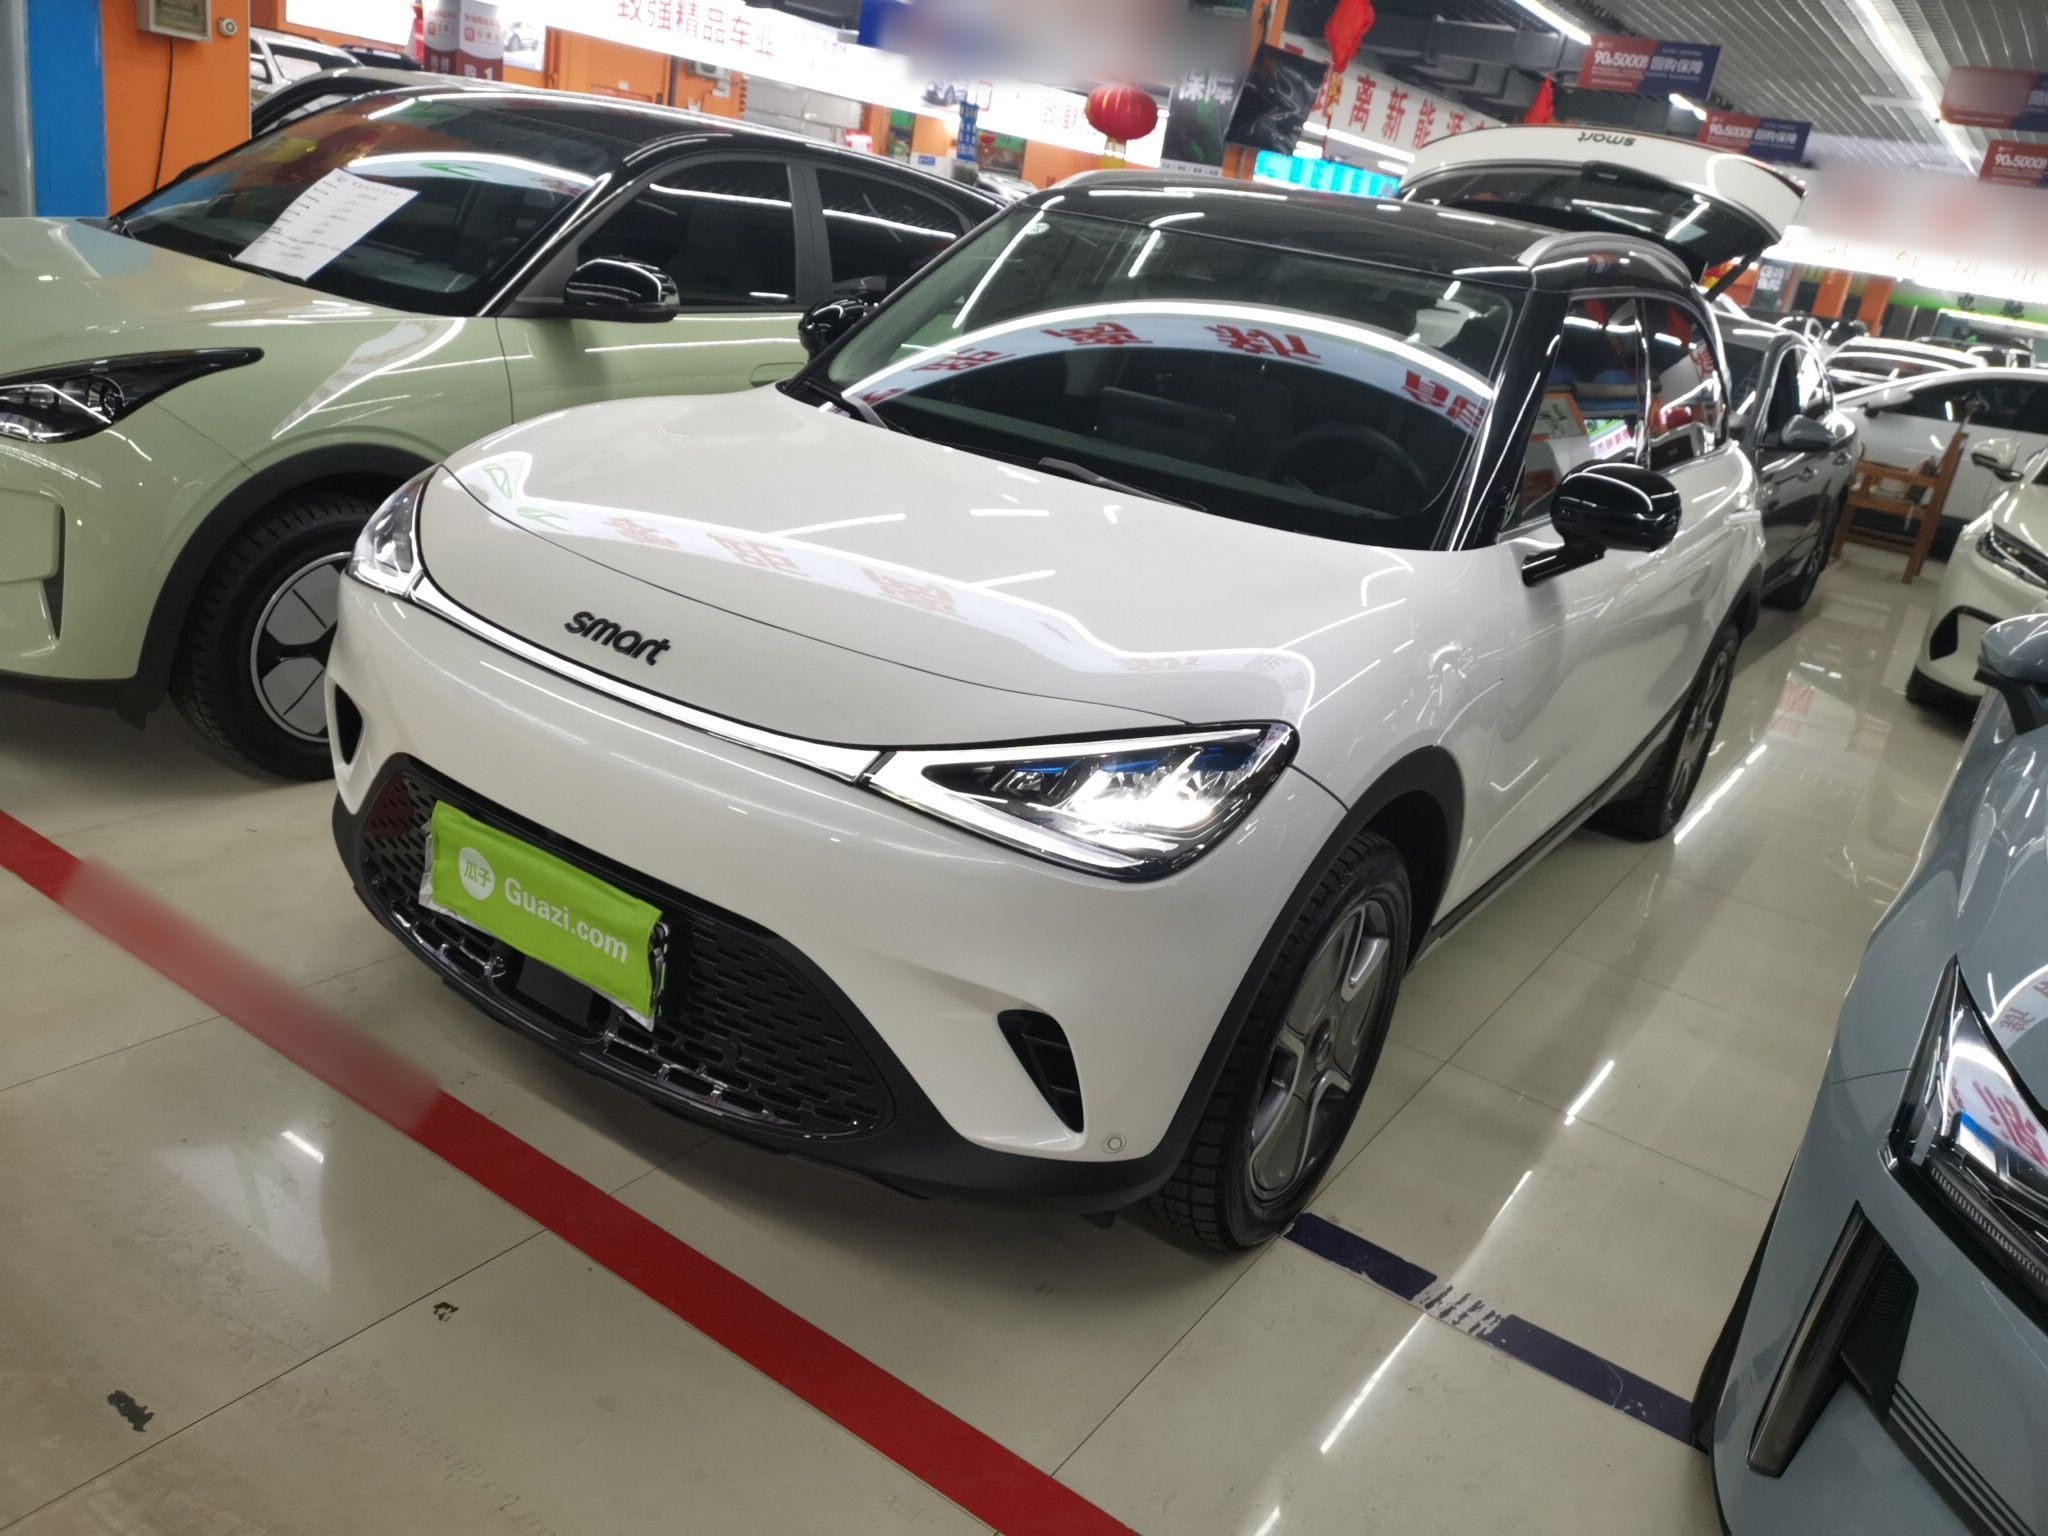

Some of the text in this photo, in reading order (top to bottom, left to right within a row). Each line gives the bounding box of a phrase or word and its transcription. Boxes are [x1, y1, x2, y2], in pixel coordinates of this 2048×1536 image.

[1577, 131, 1636, 147] smart
[564, 611, 671, 666] smart
[463, 860, 491, 888] 瓜子
[504, 877, 628, 964] Guazi.com
